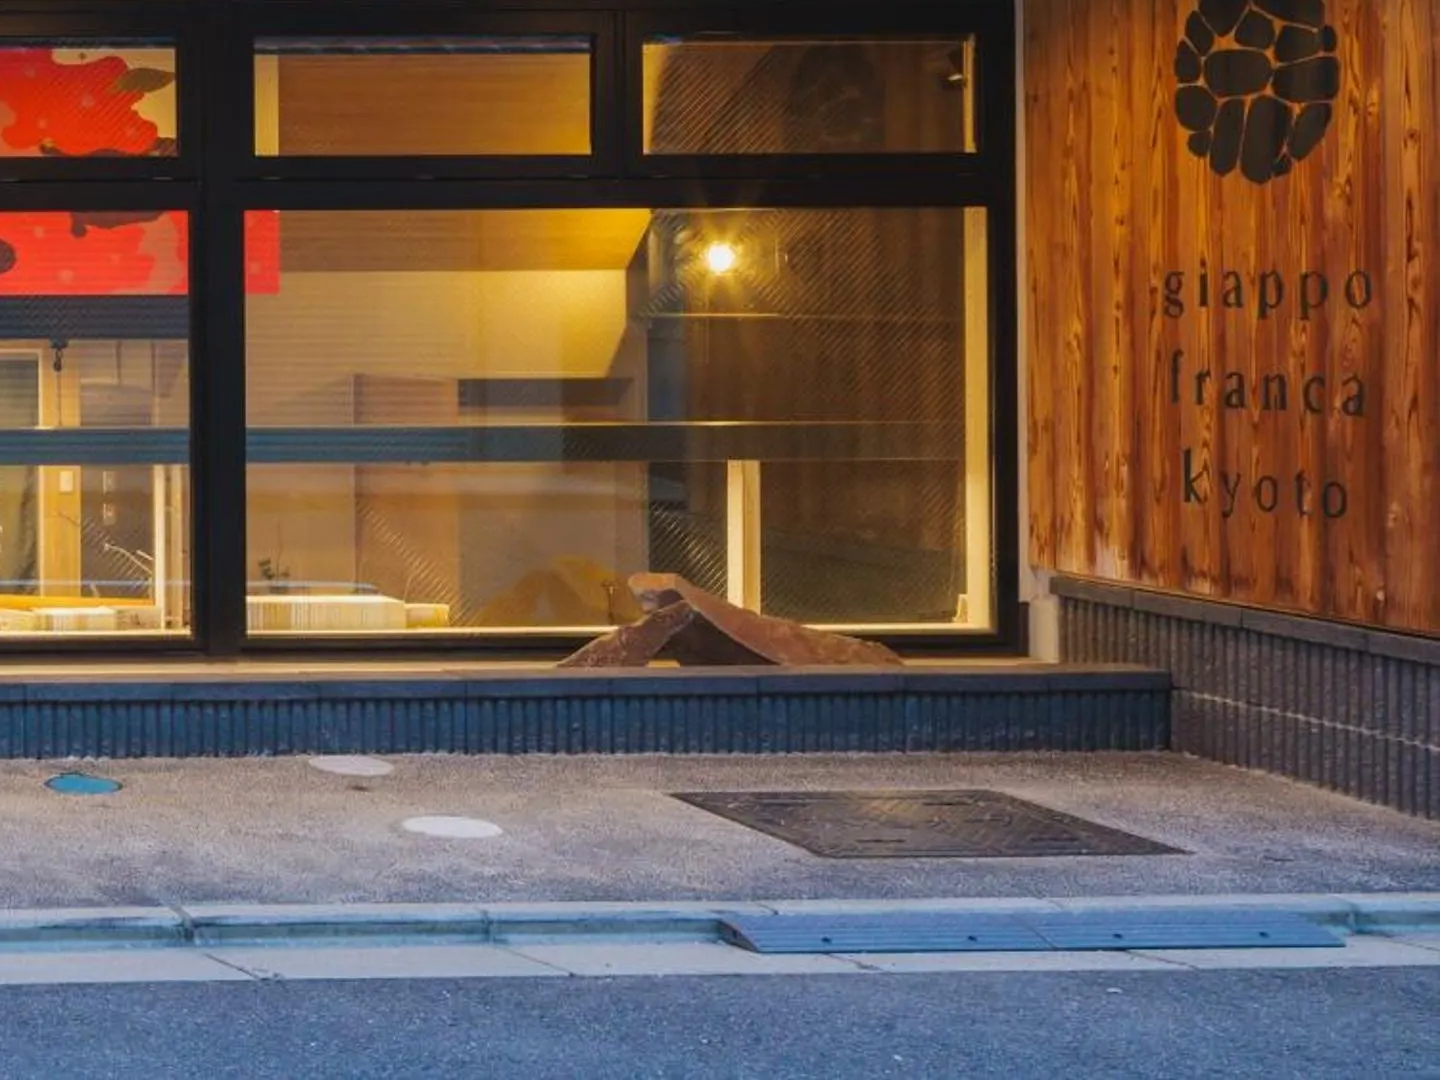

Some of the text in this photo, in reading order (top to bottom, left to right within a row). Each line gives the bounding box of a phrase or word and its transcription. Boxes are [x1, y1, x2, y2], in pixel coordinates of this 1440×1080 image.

[1163, 257, 1372, 321] giappo
[1170, 349, 1365, 417] franca
[1182, 447, 1348, 519] kyoto
